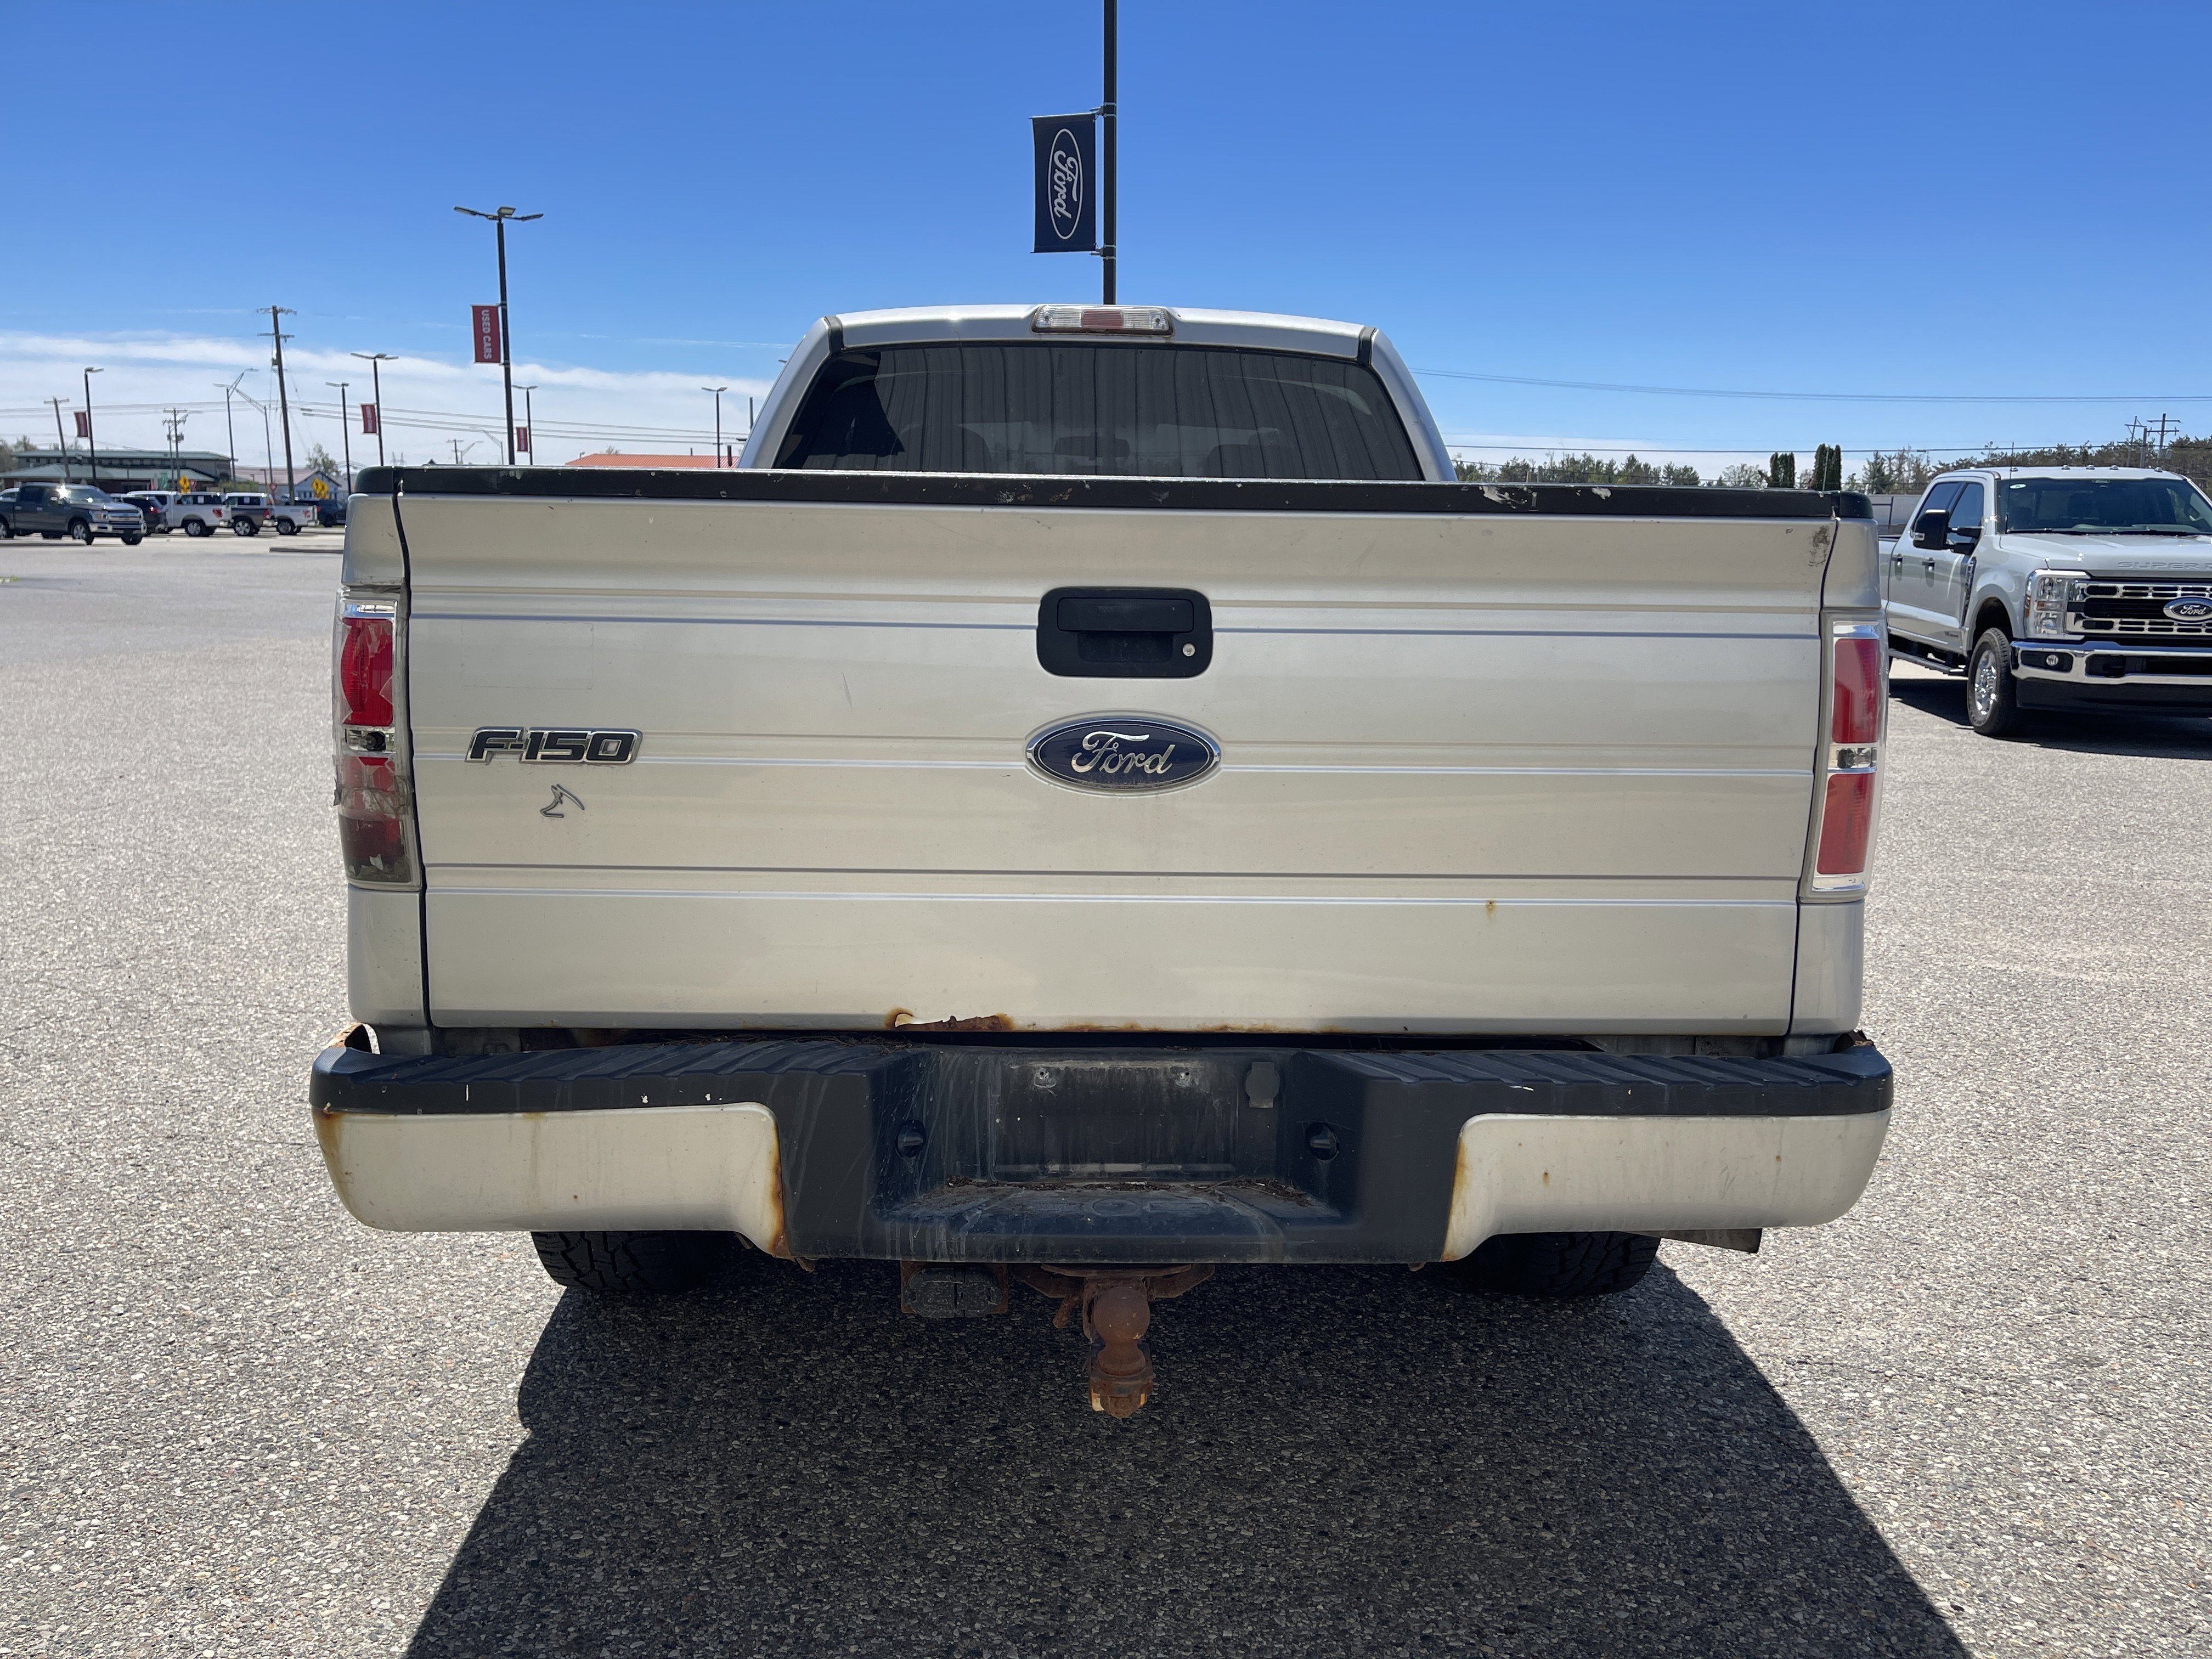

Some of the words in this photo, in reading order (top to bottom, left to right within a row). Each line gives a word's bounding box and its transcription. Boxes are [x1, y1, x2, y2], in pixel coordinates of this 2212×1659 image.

[1053, 150, 1079, 218] Ford
[481, 309, 491, 334] USED
[482, 335, 493, 360] CARS
[2117, 561, 2200, 570] SUPER
[2180, 604, 2207, 615] Ford
[465, 726, 643, 766] F-150
[1071, 731, 1176, 774] Ford
